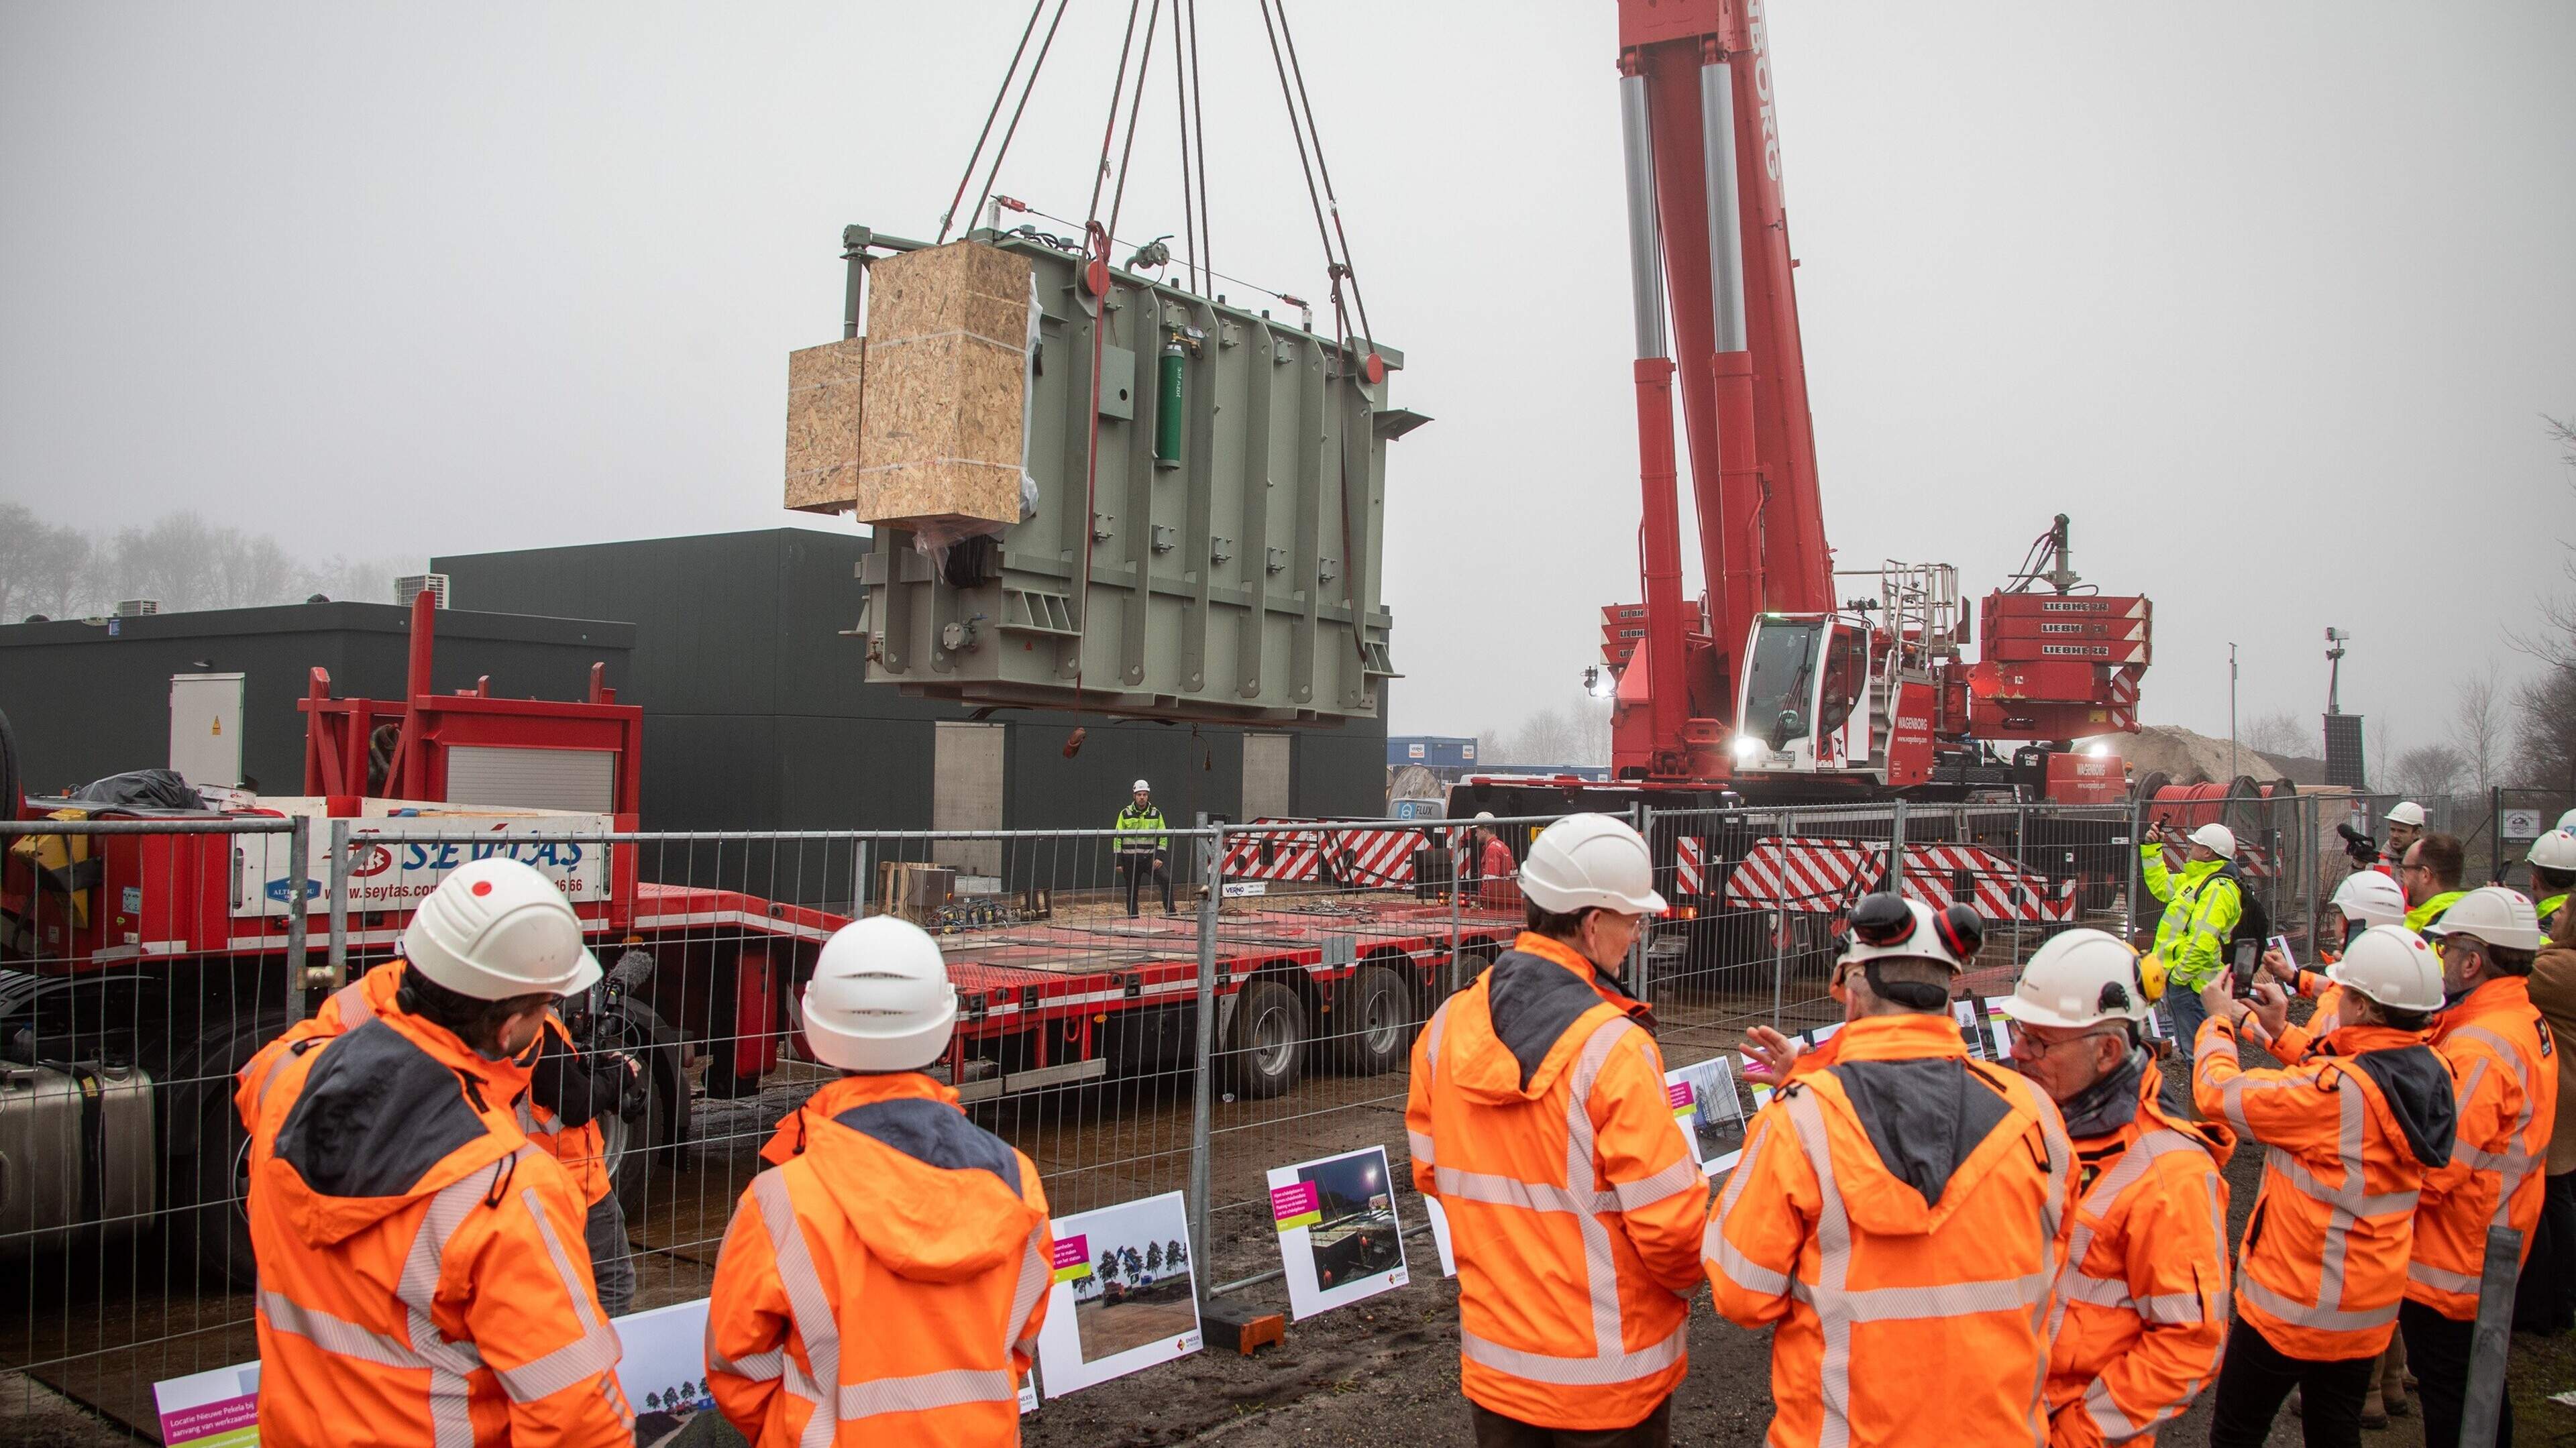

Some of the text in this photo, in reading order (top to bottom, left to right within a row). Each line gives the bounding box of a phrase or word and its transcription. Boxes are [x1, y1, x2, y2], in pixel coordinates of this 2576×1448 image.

[1897, 716, 1927, 730] WAGENBORG
[1416, 805, 1433, 816] FLUX
[570, 879, 582, 891] 66
[170, 1402, 254, 1427] Locatie Nieuwe Pekela bij
[172, 1425, 201, 1438] aanvang
[202, 1423, 214, 1431] van
